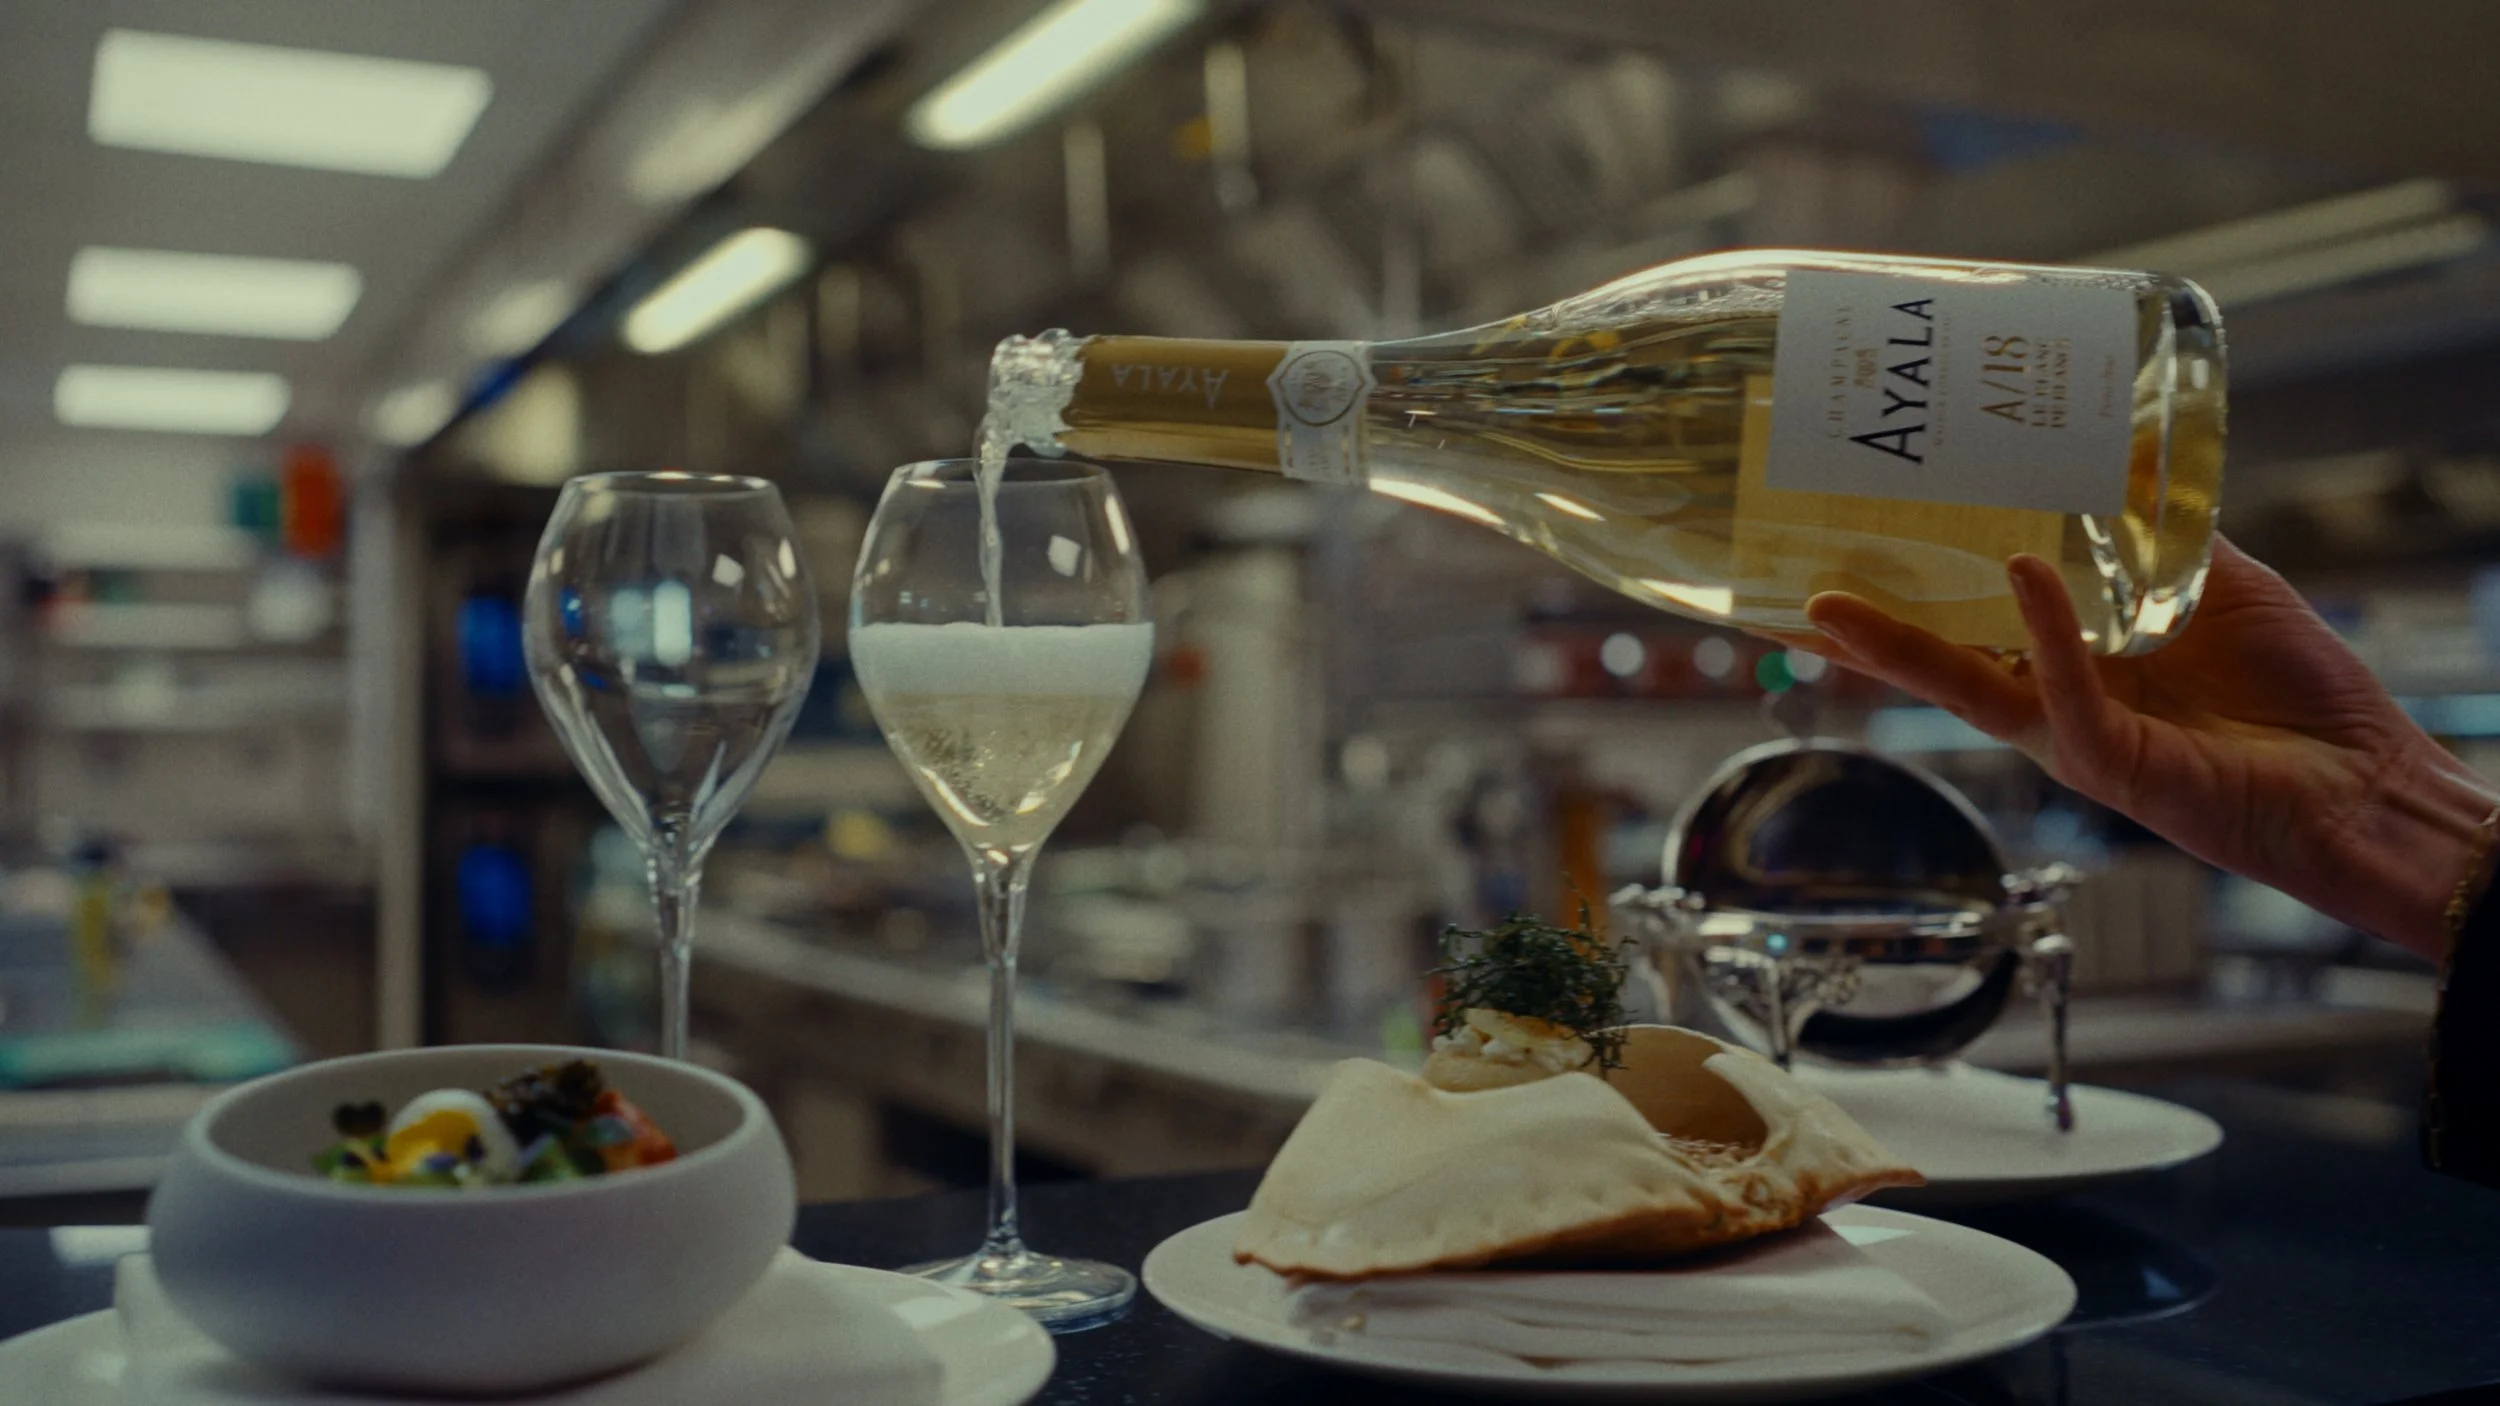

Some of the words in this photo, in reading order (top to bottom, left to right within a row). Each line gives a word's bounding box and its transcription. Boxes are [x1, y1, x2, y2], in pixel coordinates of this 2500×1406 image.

[1110, 363, 1229, 412] AYALA
[1826, 306, 1851, 440] CHAMPAGNE
[1847, 298, 1934, 466] AYALA
[1978, 335, 2031, 425] A/18
